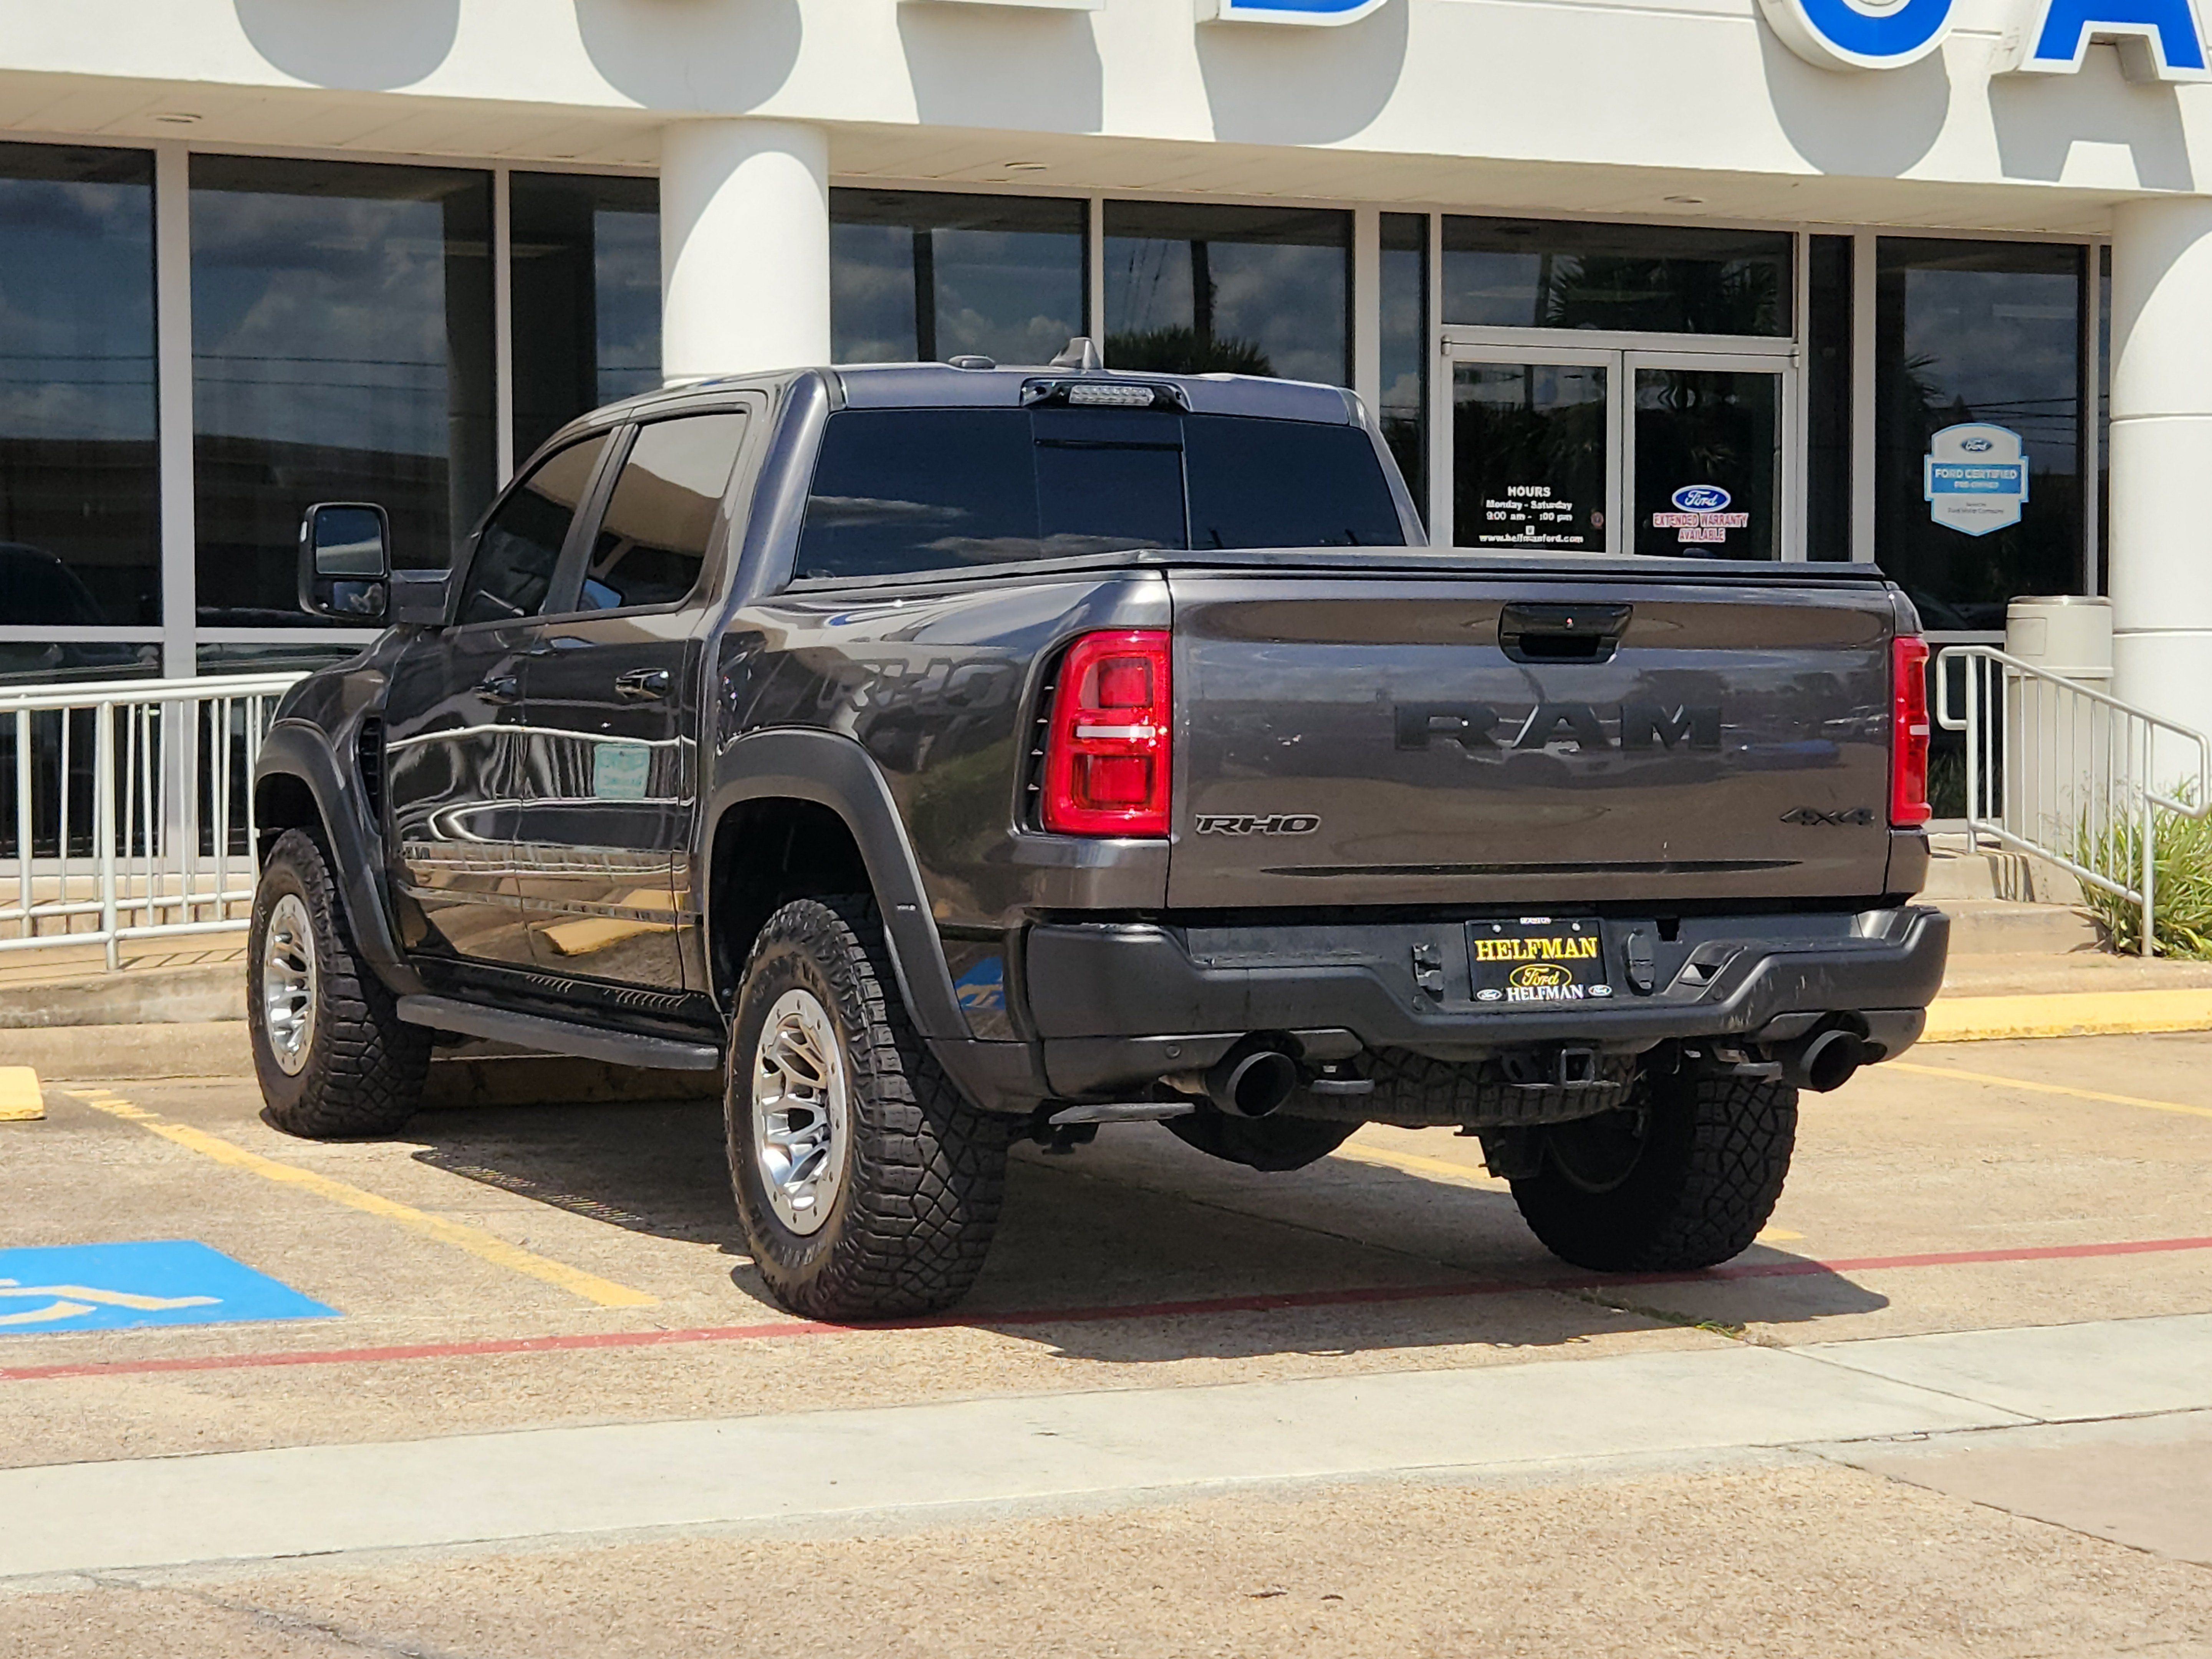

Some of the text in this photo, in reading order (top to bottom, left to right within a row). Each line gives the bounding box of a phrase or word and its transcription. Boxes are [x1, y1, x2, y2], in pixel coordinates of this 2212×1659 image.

[1935, 469, 2017, 479] FORD CERTIFIED
[1507, 485, 1551, 497] HOURS
[1684, 490, 1719, 506] Ford
[1486, 499, 1523, 511] Monday
[1531, 500, 1573, 511] Saturday
[1556, 514, 1573, 523] pm
[1654, 513, 1748, 527] EXTENDED WARRANTY
[1479, 533, 1584, 543] www.helfmanford.com
[1679, 528, 1725, 541] AVAILABLE
[1395, 704, 1721, 750] RAM
[1195, 813, 1321, 836] RHO
[1474, 937, 1597, 960] HELFMAN
[1522, 967, 1560, 986] Ford
[1506, 984, 1584, 1001] HELFMAN
